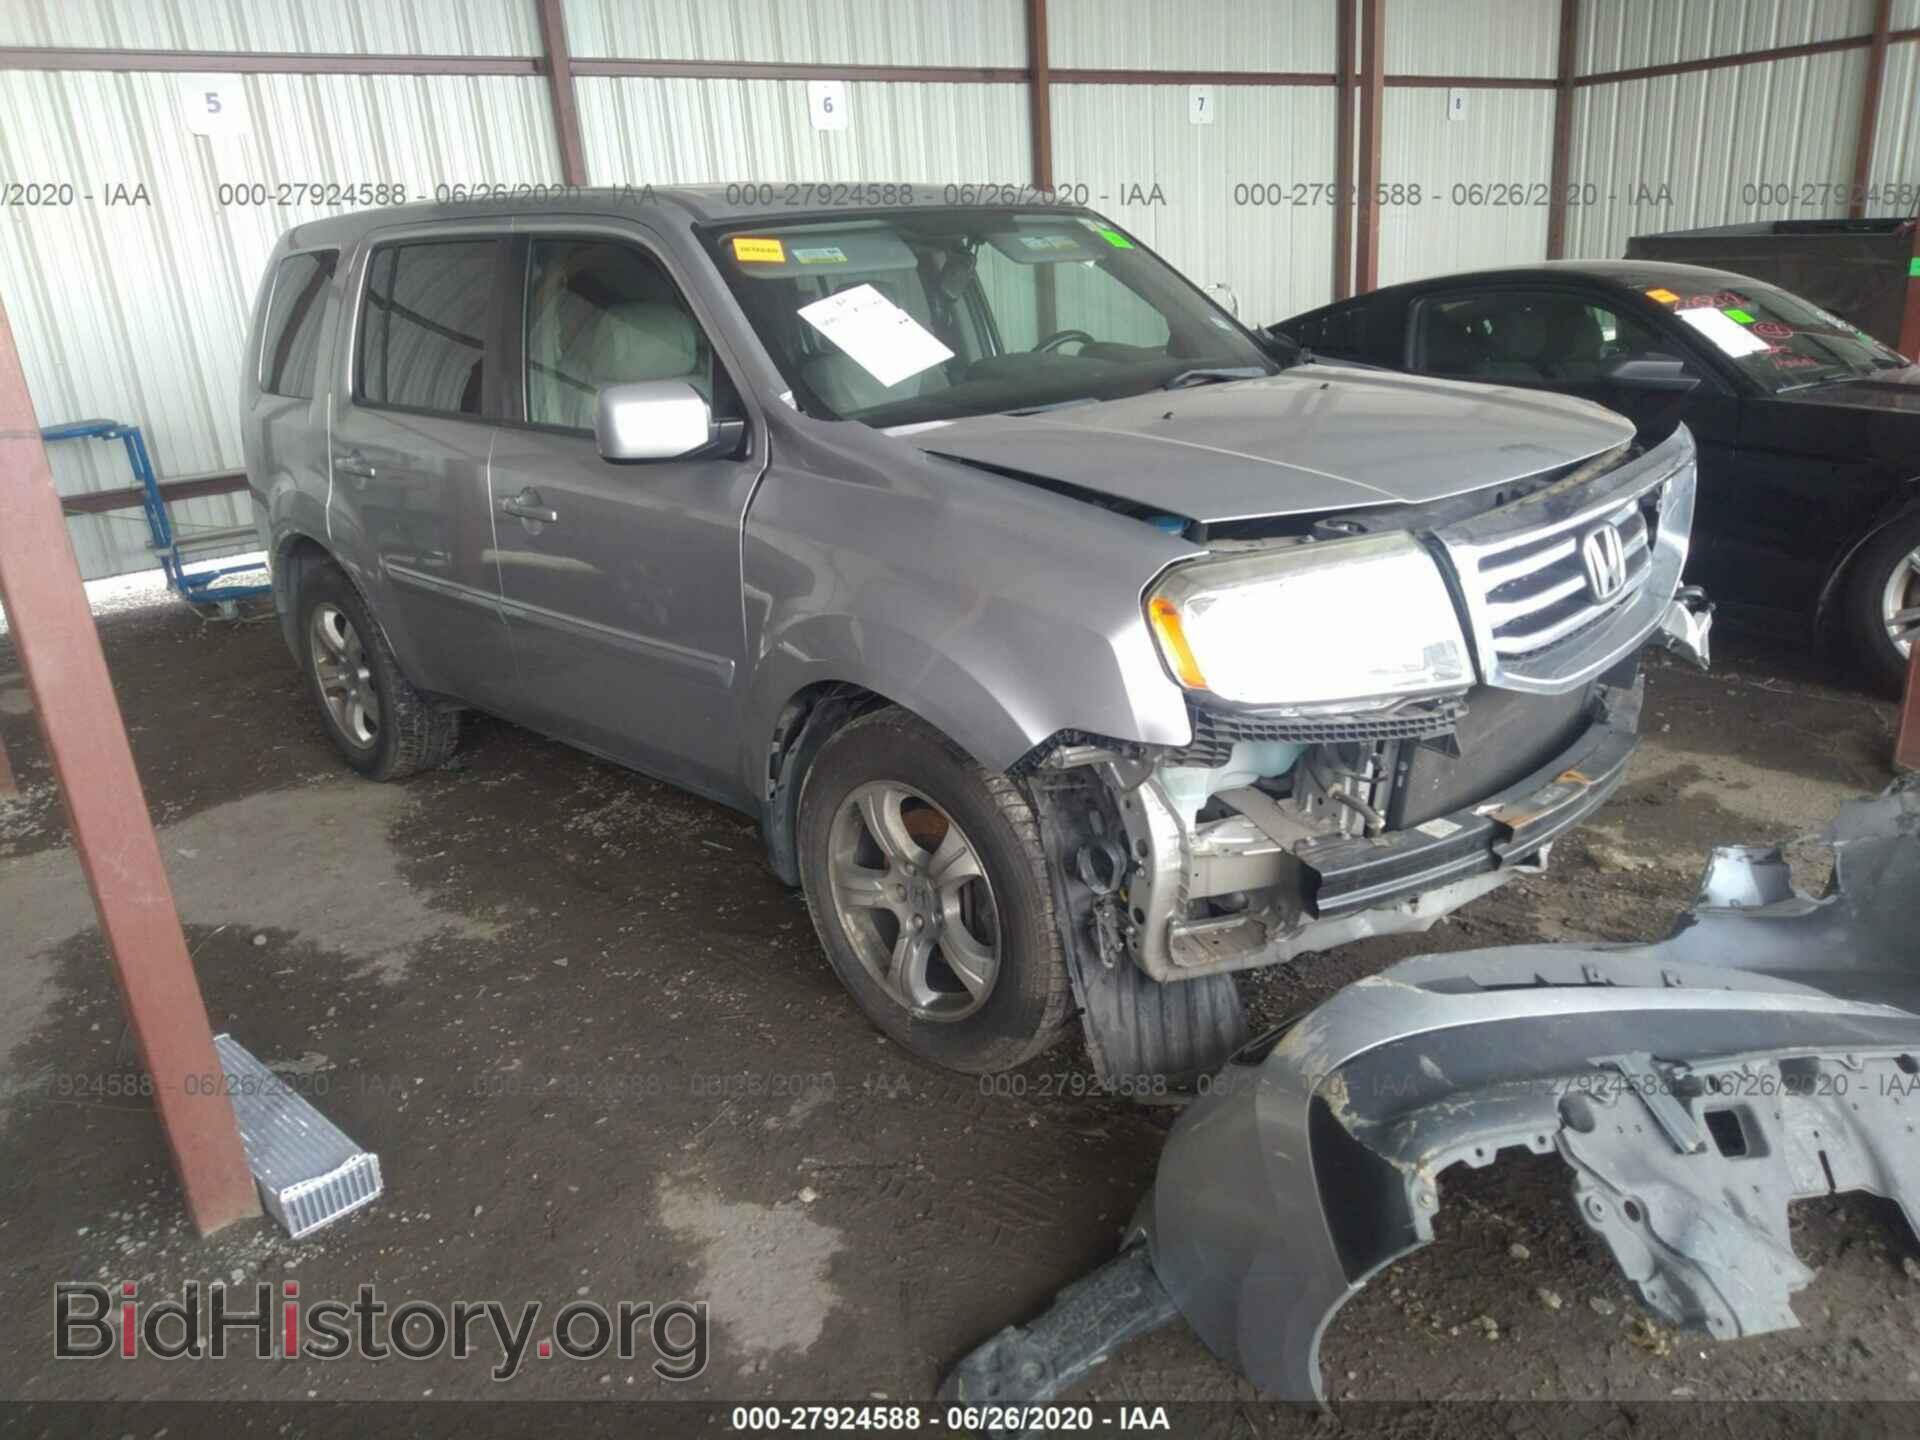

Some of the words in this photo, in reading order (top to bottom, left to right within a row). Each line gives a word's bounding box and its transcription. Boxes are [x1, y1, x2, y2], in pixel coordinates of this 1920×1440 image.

[205, 92, 221, 114] 5
[823, 97, 833, 113] 6
[1198, 97, 1205, 111] 7
